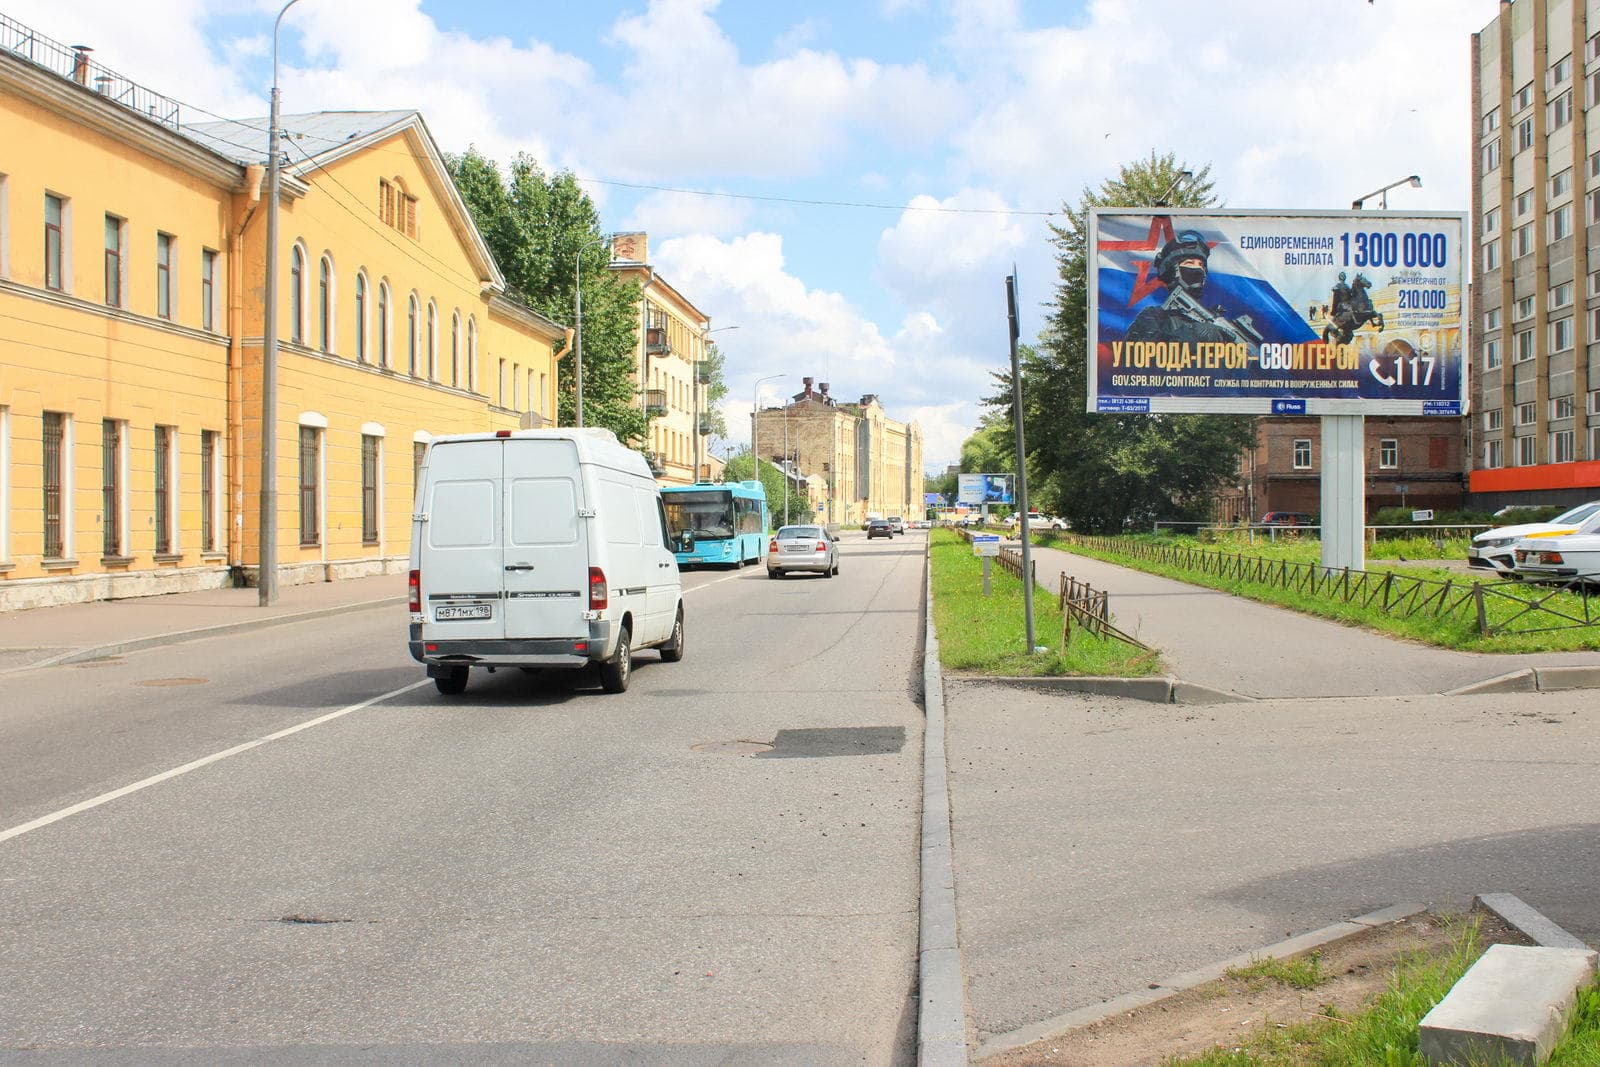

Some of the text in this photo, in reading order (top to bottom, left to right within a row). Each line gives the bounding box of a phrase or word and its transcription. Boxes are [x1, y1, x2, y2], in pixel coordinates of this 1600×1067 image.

[1240, 236, 1334, 249] ЕДИНОВРЕМЕННАЯ
[1284, 252, 1334, 266] ВЫПЛАТА
[1112, 341, 1123, 368] У
[1125, 341, 1247, 372] ГОРОДА-ГЕРОЯ
[1260, 343, 1304, 370] СВОИ
[1307, 343, 1360, 370] ГЕРОИ
[1394, 356, 1436, 386] 117
[1112, 374, 1211, 388] GOV.SPB.RU/CONTRACT
[1213, 379, 1359, 389] СЛУЖБА ПО КОНТРАКТУ В ВООРУЖЕННЫХ СИЛАХ
[438, 608, 473, 617] М871МХ
